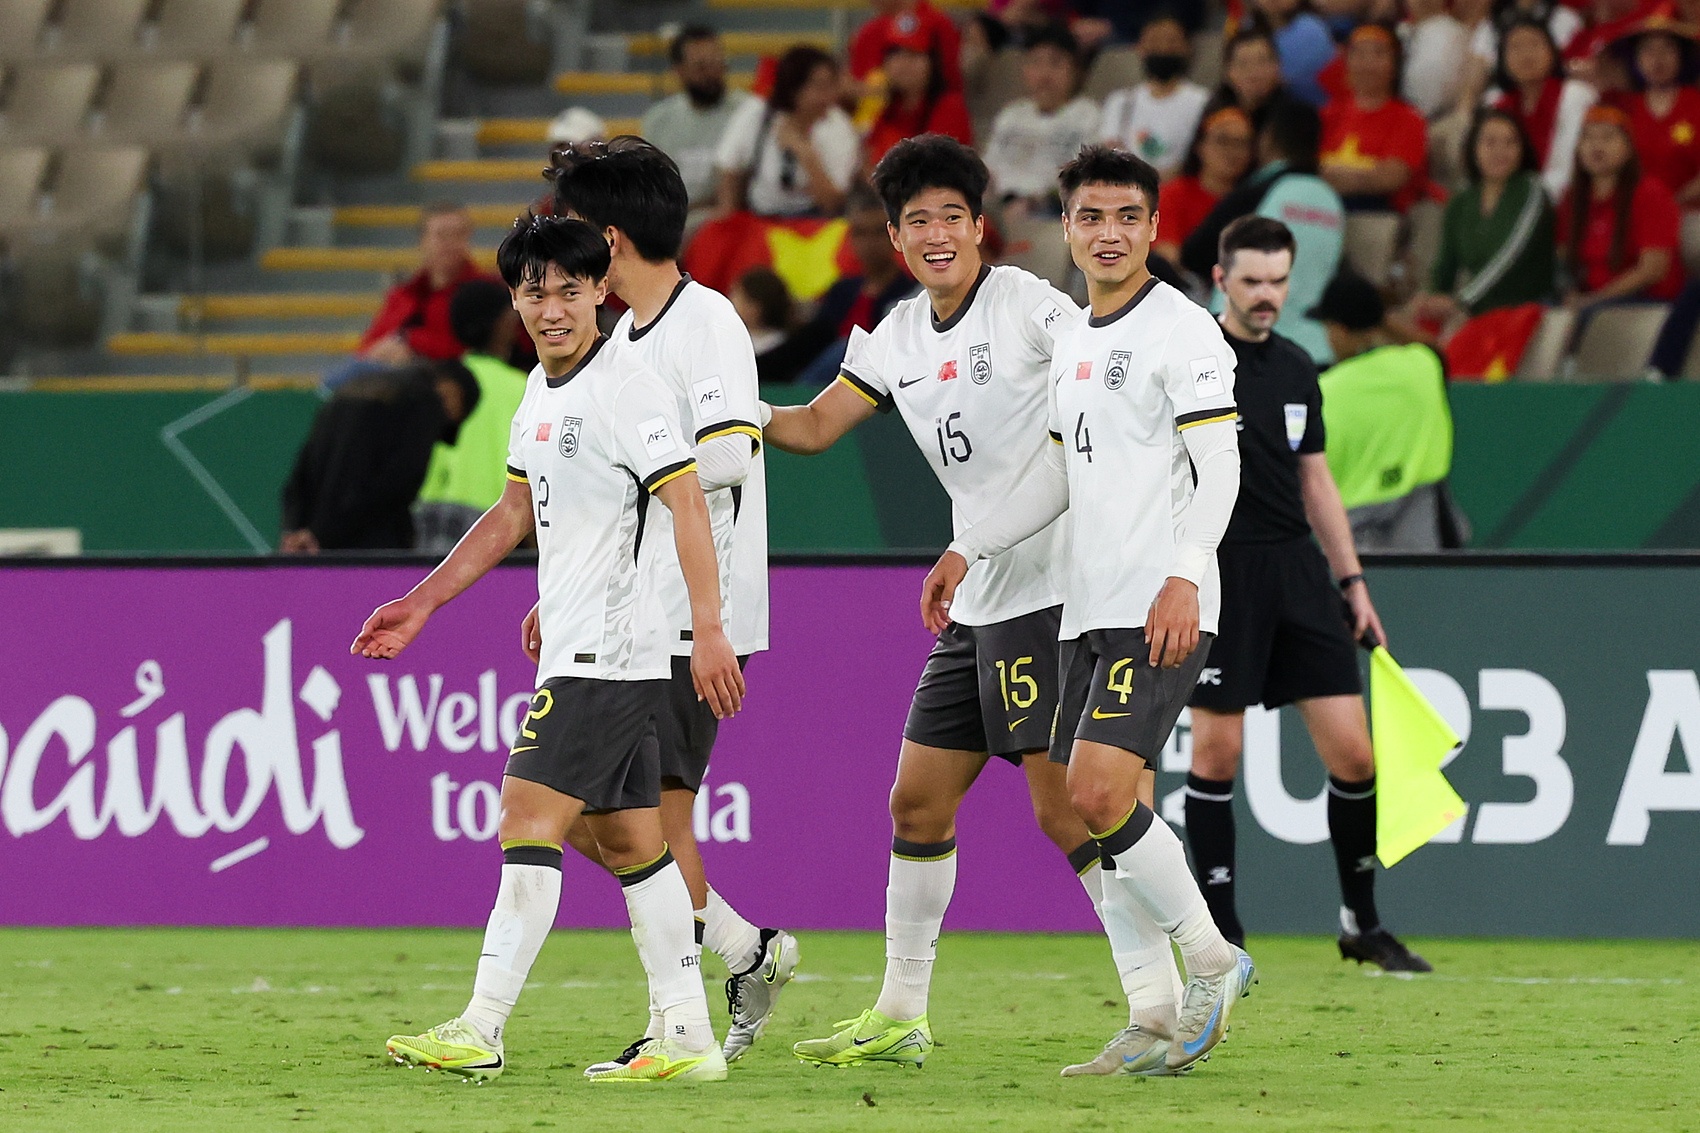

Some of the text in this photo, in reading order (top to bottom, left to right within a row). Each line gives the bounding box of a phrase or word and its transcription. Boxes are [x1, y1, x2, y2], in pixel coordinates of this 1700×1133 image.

[700, 389, 720, 404] AFC
[1196, 370, 1217, 383] AFC
[647, 429, 667, 445] AFC
[936, 411, 973, 467] 15
[1075, 412, 1093, 463] 4
[538, 475, 550, 527] 2
[995, 656, 1038, 711] 15
[1106, 657, 1134, 704] 4
[366, 668, 535, 753] Welc
[522, 688, 554, 740] 2
[0, 617, 365, 873] audi
[431, 771, 501, 842] to
